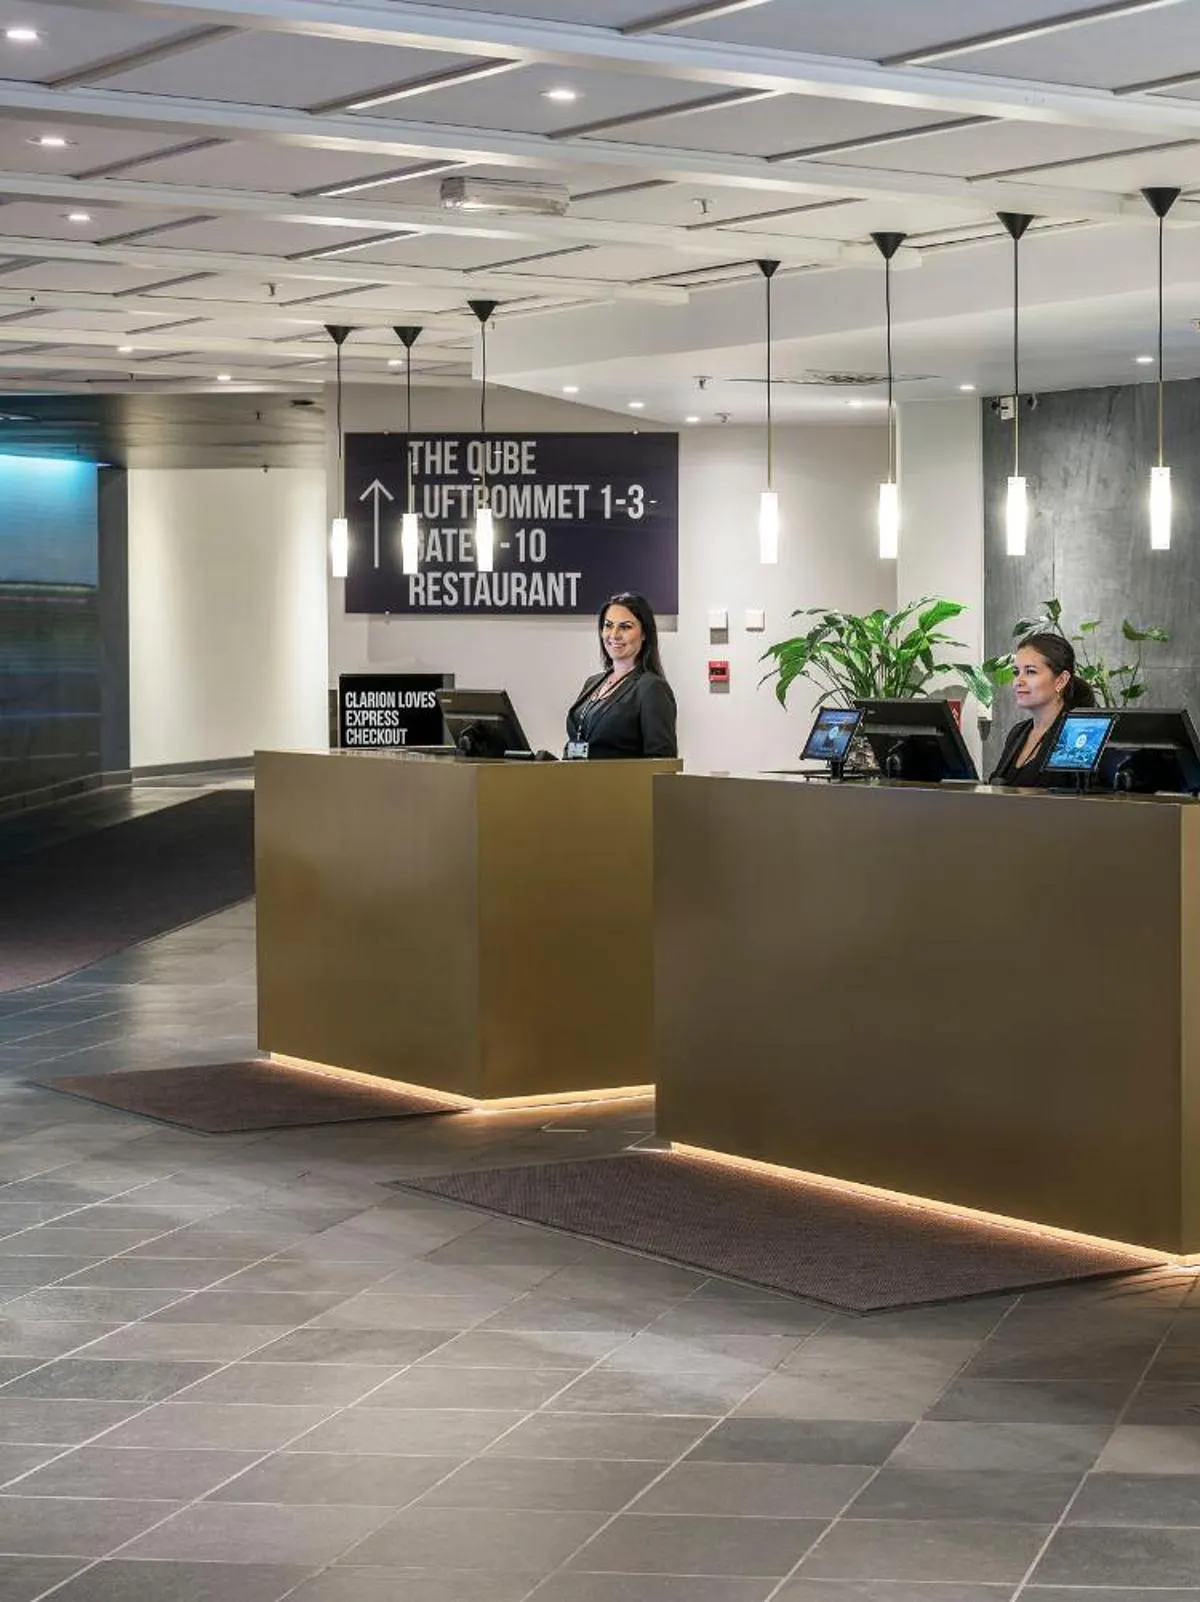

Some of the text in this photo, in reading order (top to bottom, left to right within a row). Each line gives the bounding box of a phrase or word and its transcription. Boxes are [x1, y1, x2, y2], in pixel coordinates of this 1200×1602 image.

[408, 441, 537, 475] THE QUBE
[601, 484, 645, 519] 1-3
[409, 572, 582, 607] RESTAURANT
[345, 691, 436, 709] CLARION LOVES
[345, 709, 399, 727] EXPRESS
[346, 728, 408, 745] CHECKOUT
